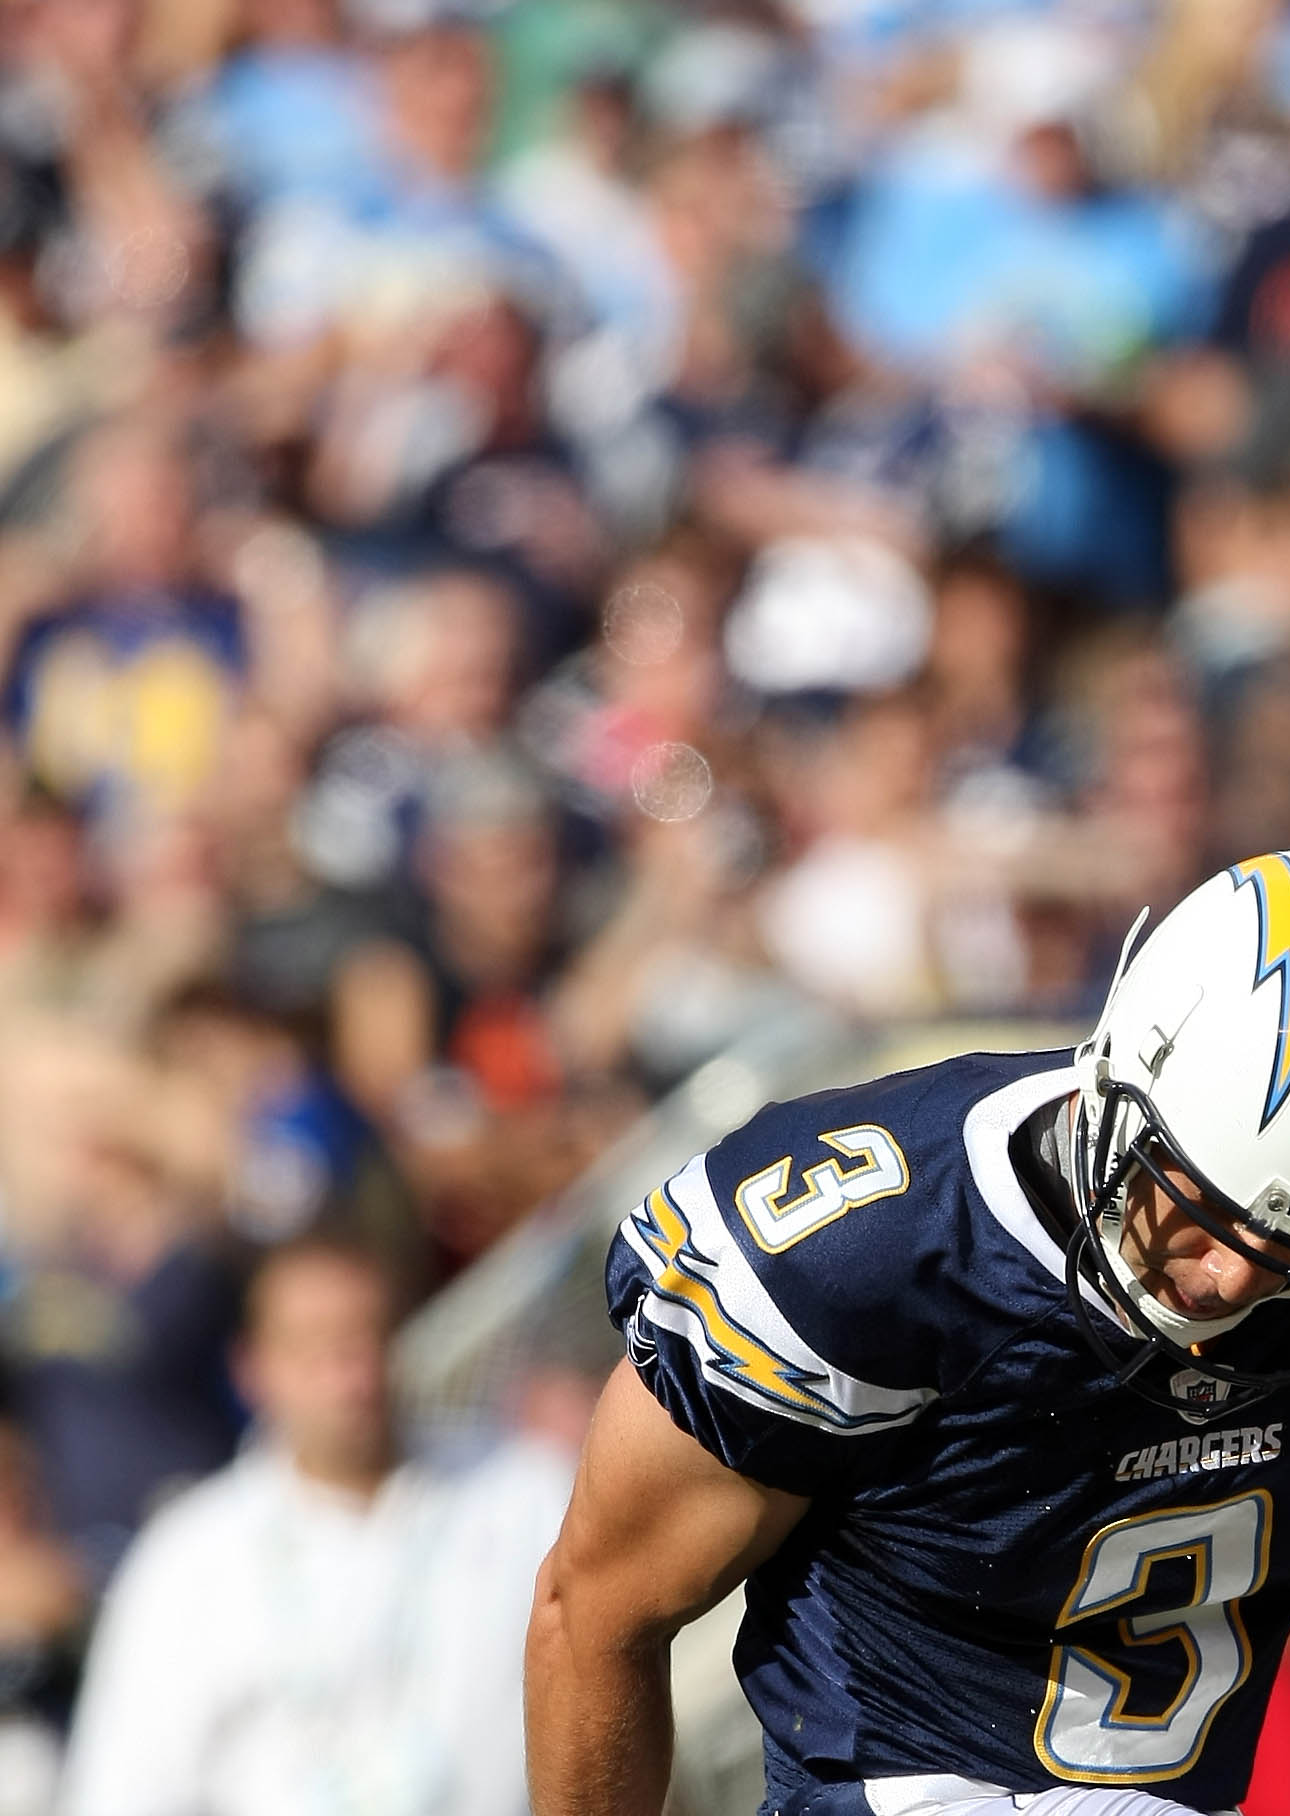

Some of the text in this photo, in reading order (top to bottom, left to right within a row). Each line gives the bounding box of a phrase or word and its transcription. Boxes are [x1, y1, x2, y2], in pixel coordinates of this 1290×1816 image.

[735, 1123, 910, 1255] 3
[1115, 1423, 1283, 1482] CHARGERS
[1033, 1488, 1273, 1784] 3
